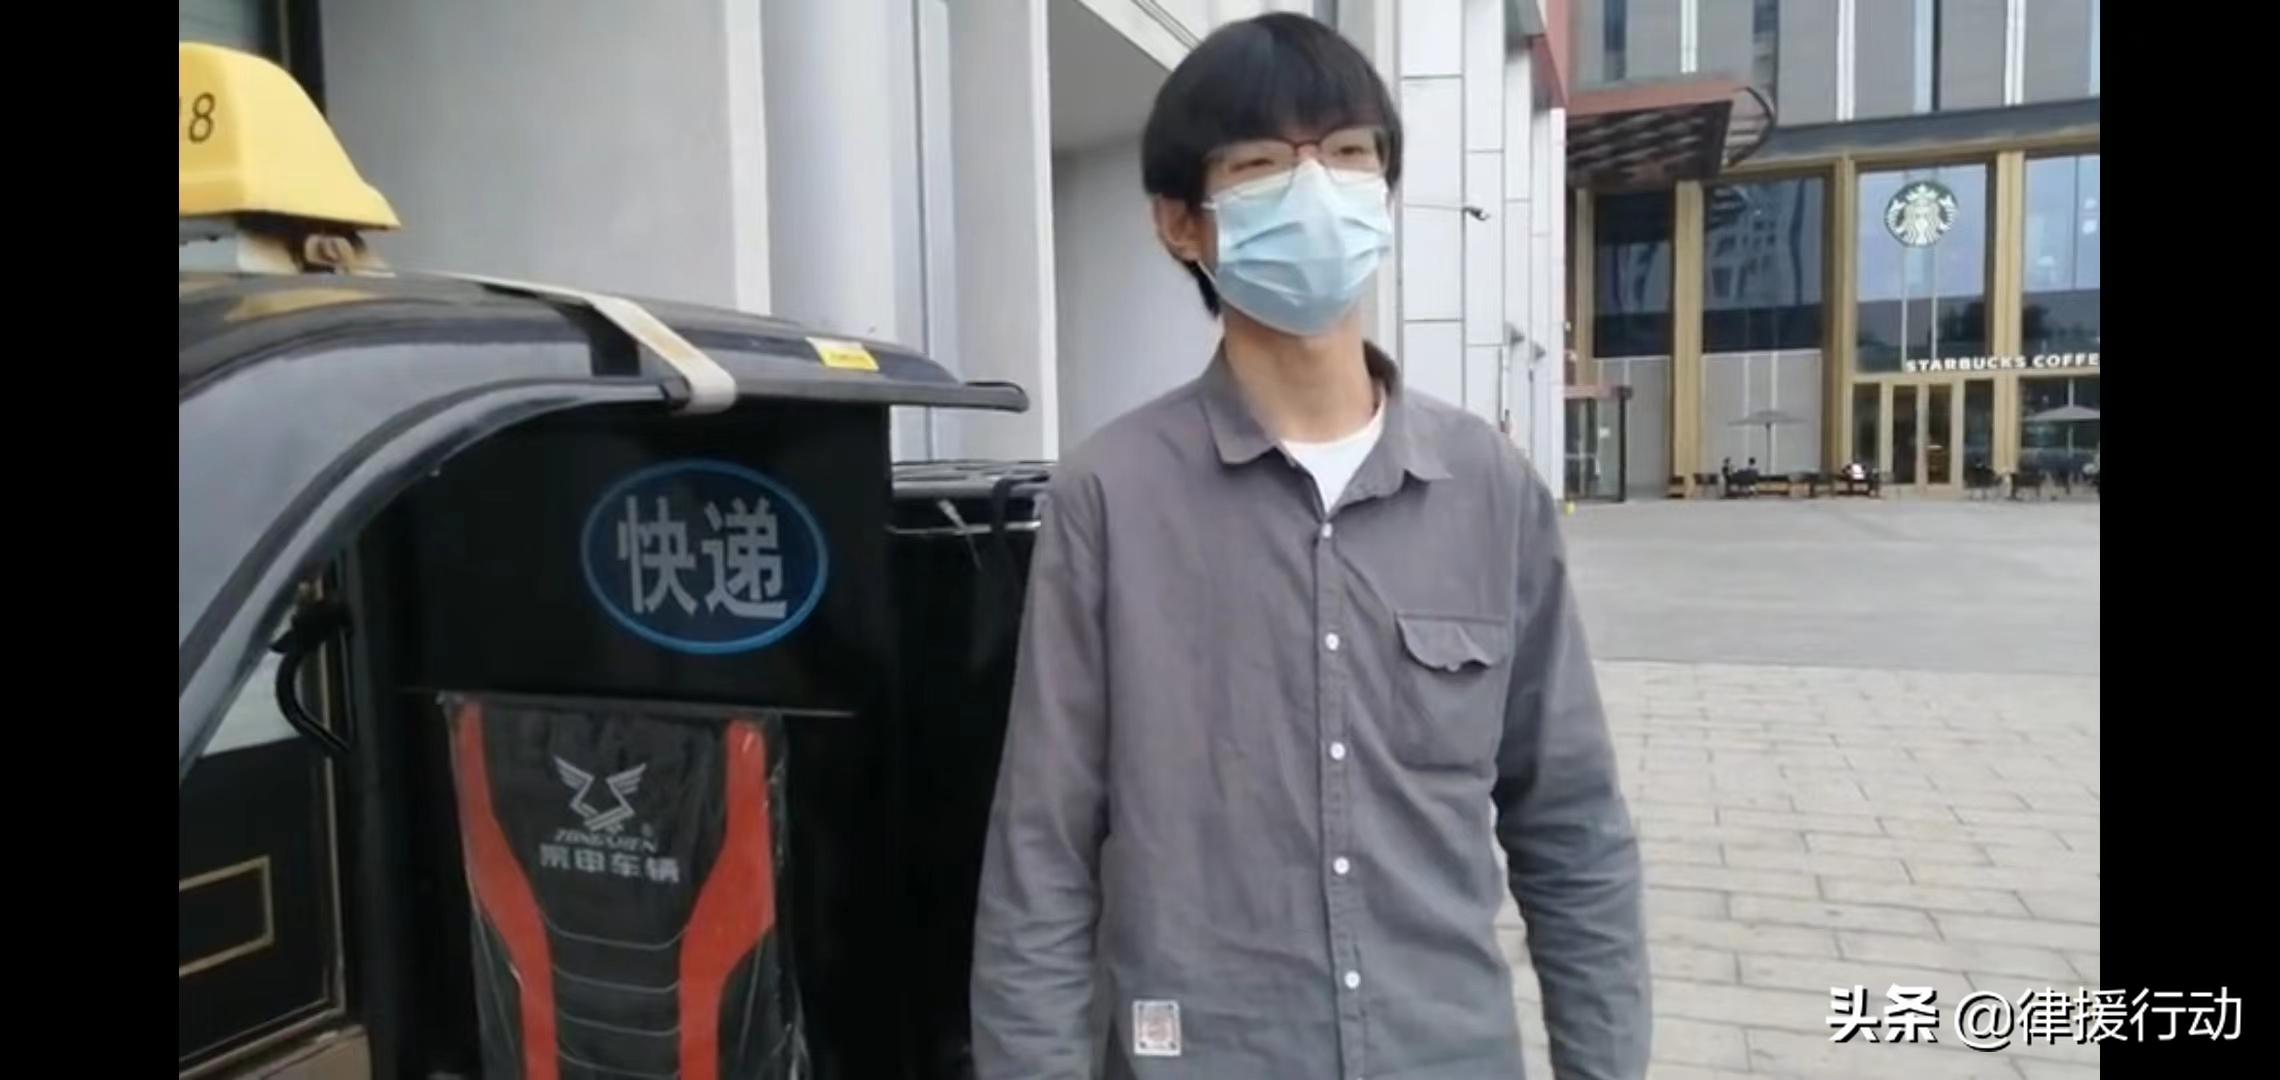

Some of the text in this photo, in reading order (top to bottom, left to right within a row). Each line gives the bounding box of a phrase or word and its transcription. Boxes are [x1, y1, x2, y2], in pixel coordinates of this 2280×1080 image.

[179, 92, 215, 144] 8
[1905, 352, 2100, 372] STARBUCKS COFFE
[617, 495, 788, 620] 快递
